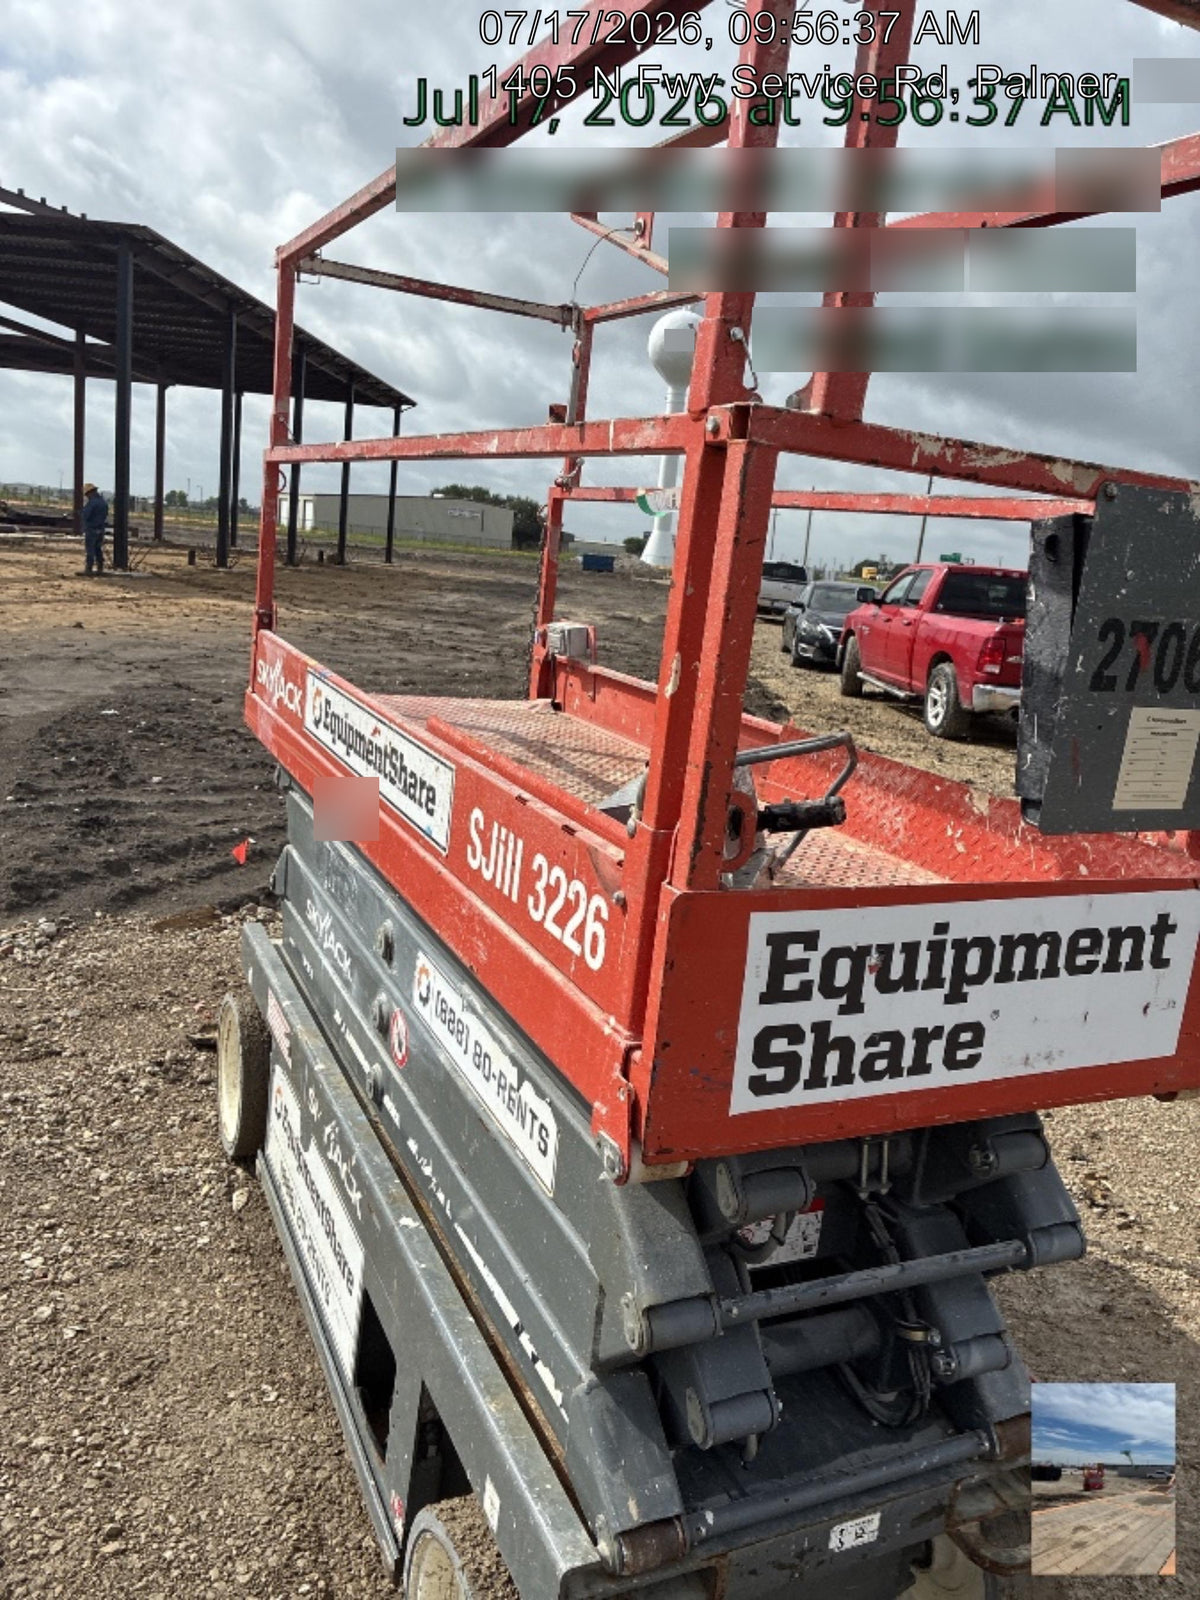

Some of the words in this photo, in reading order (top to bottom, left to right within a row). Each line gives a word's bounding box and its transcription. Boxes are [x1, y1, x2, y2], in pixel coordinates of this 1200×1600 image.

[323, 697, 437, 817] EquipmentShare
[527, 852, 609, 972] 3226
[758, 912, 1178, 1015] Equipment
[747, 1019, 986, 1097] Share
